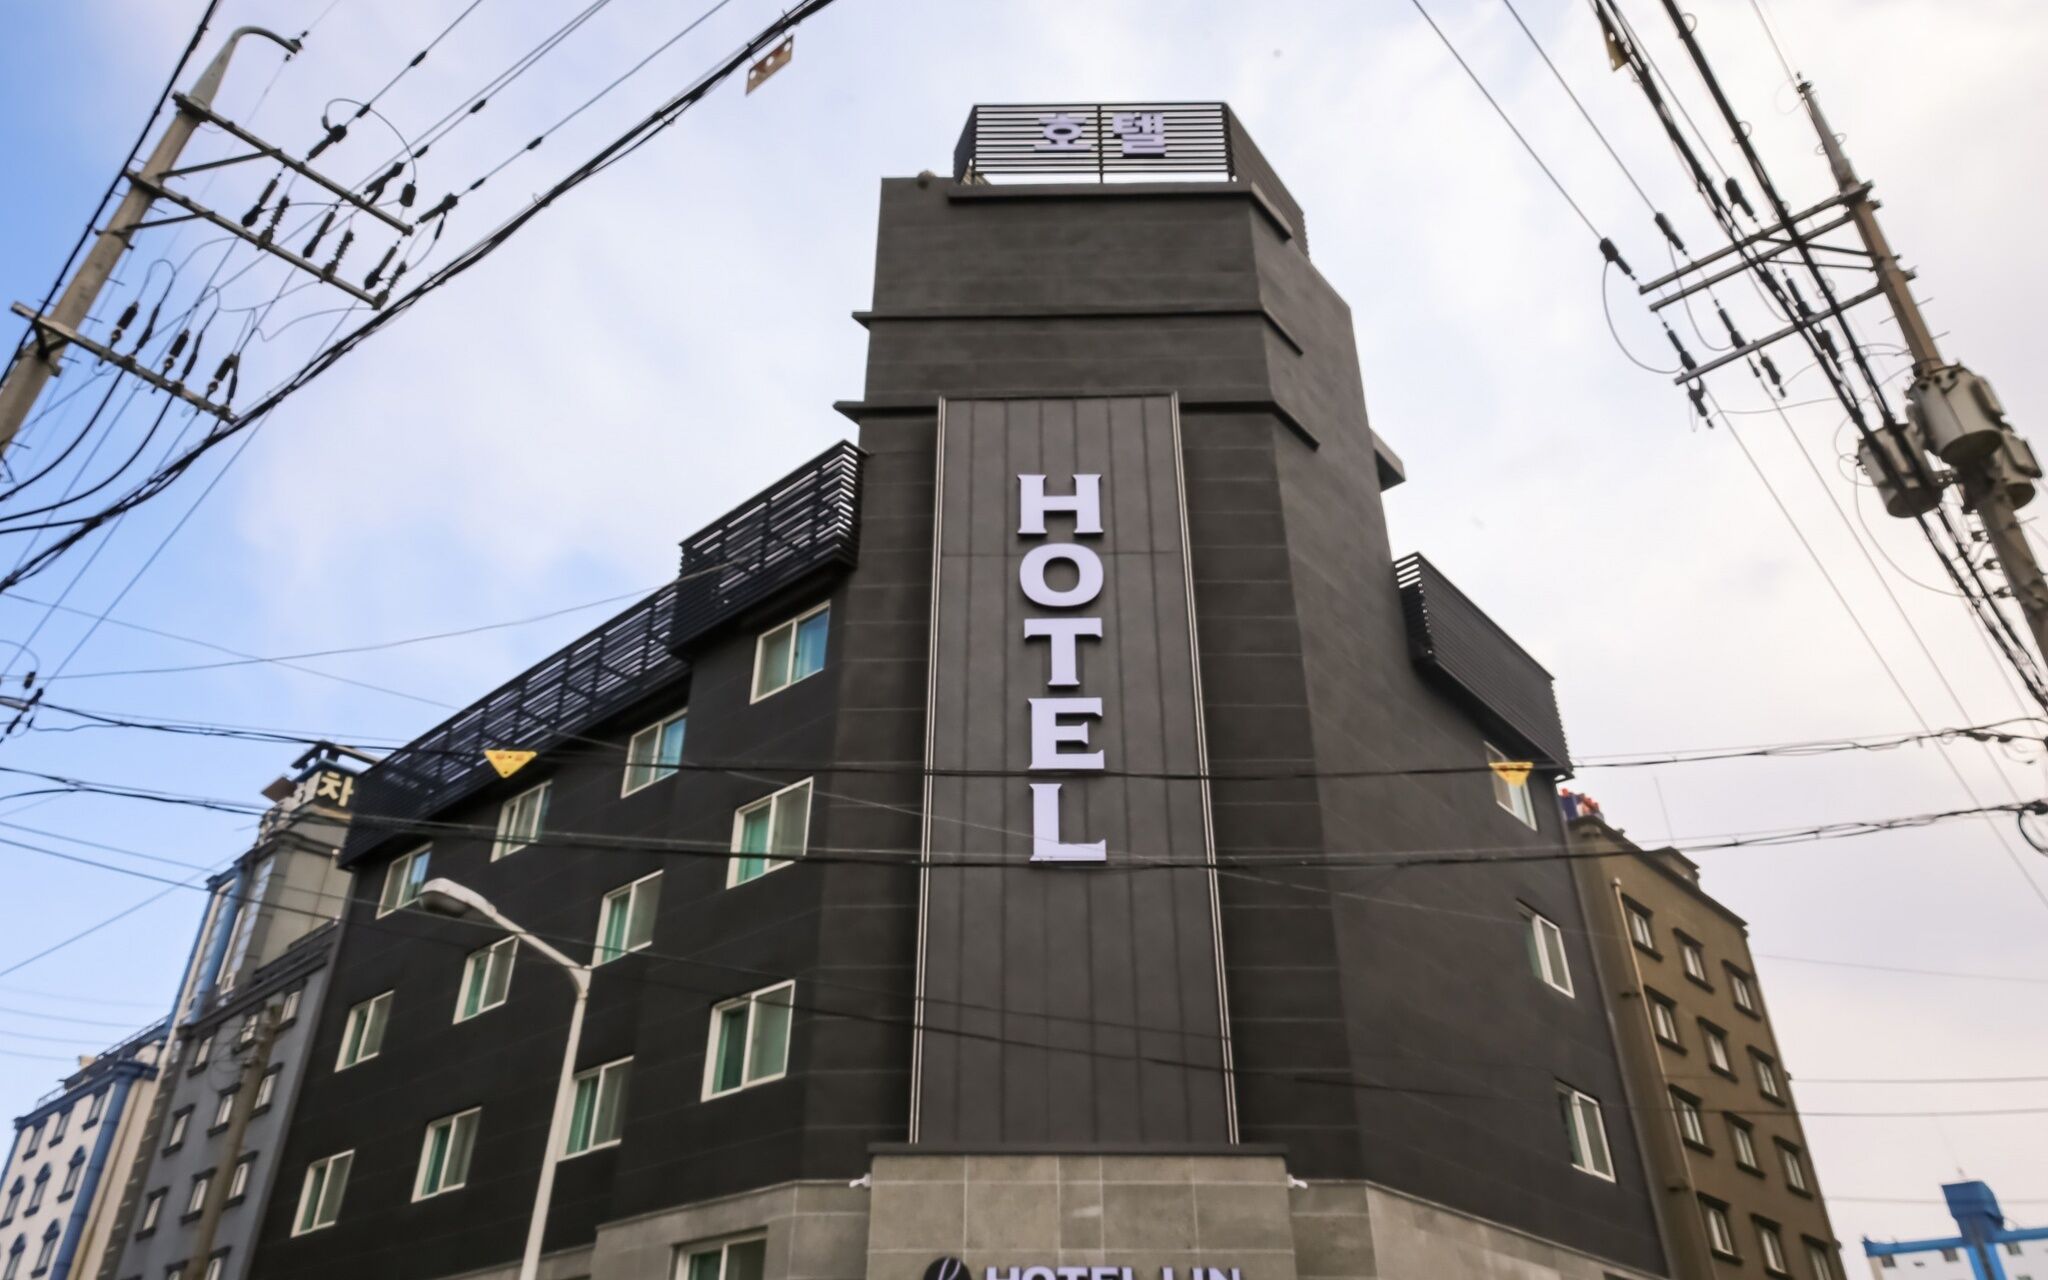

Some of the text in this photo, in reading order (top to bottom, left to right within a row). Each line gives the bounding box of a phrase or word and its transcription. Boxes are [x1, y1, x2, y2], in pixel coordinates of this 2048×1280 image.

[1033, 112, 1166, 154] 호텔
[1017, 474, 1107, 861] HOTEL
[316, 771, 354, 807] 차
